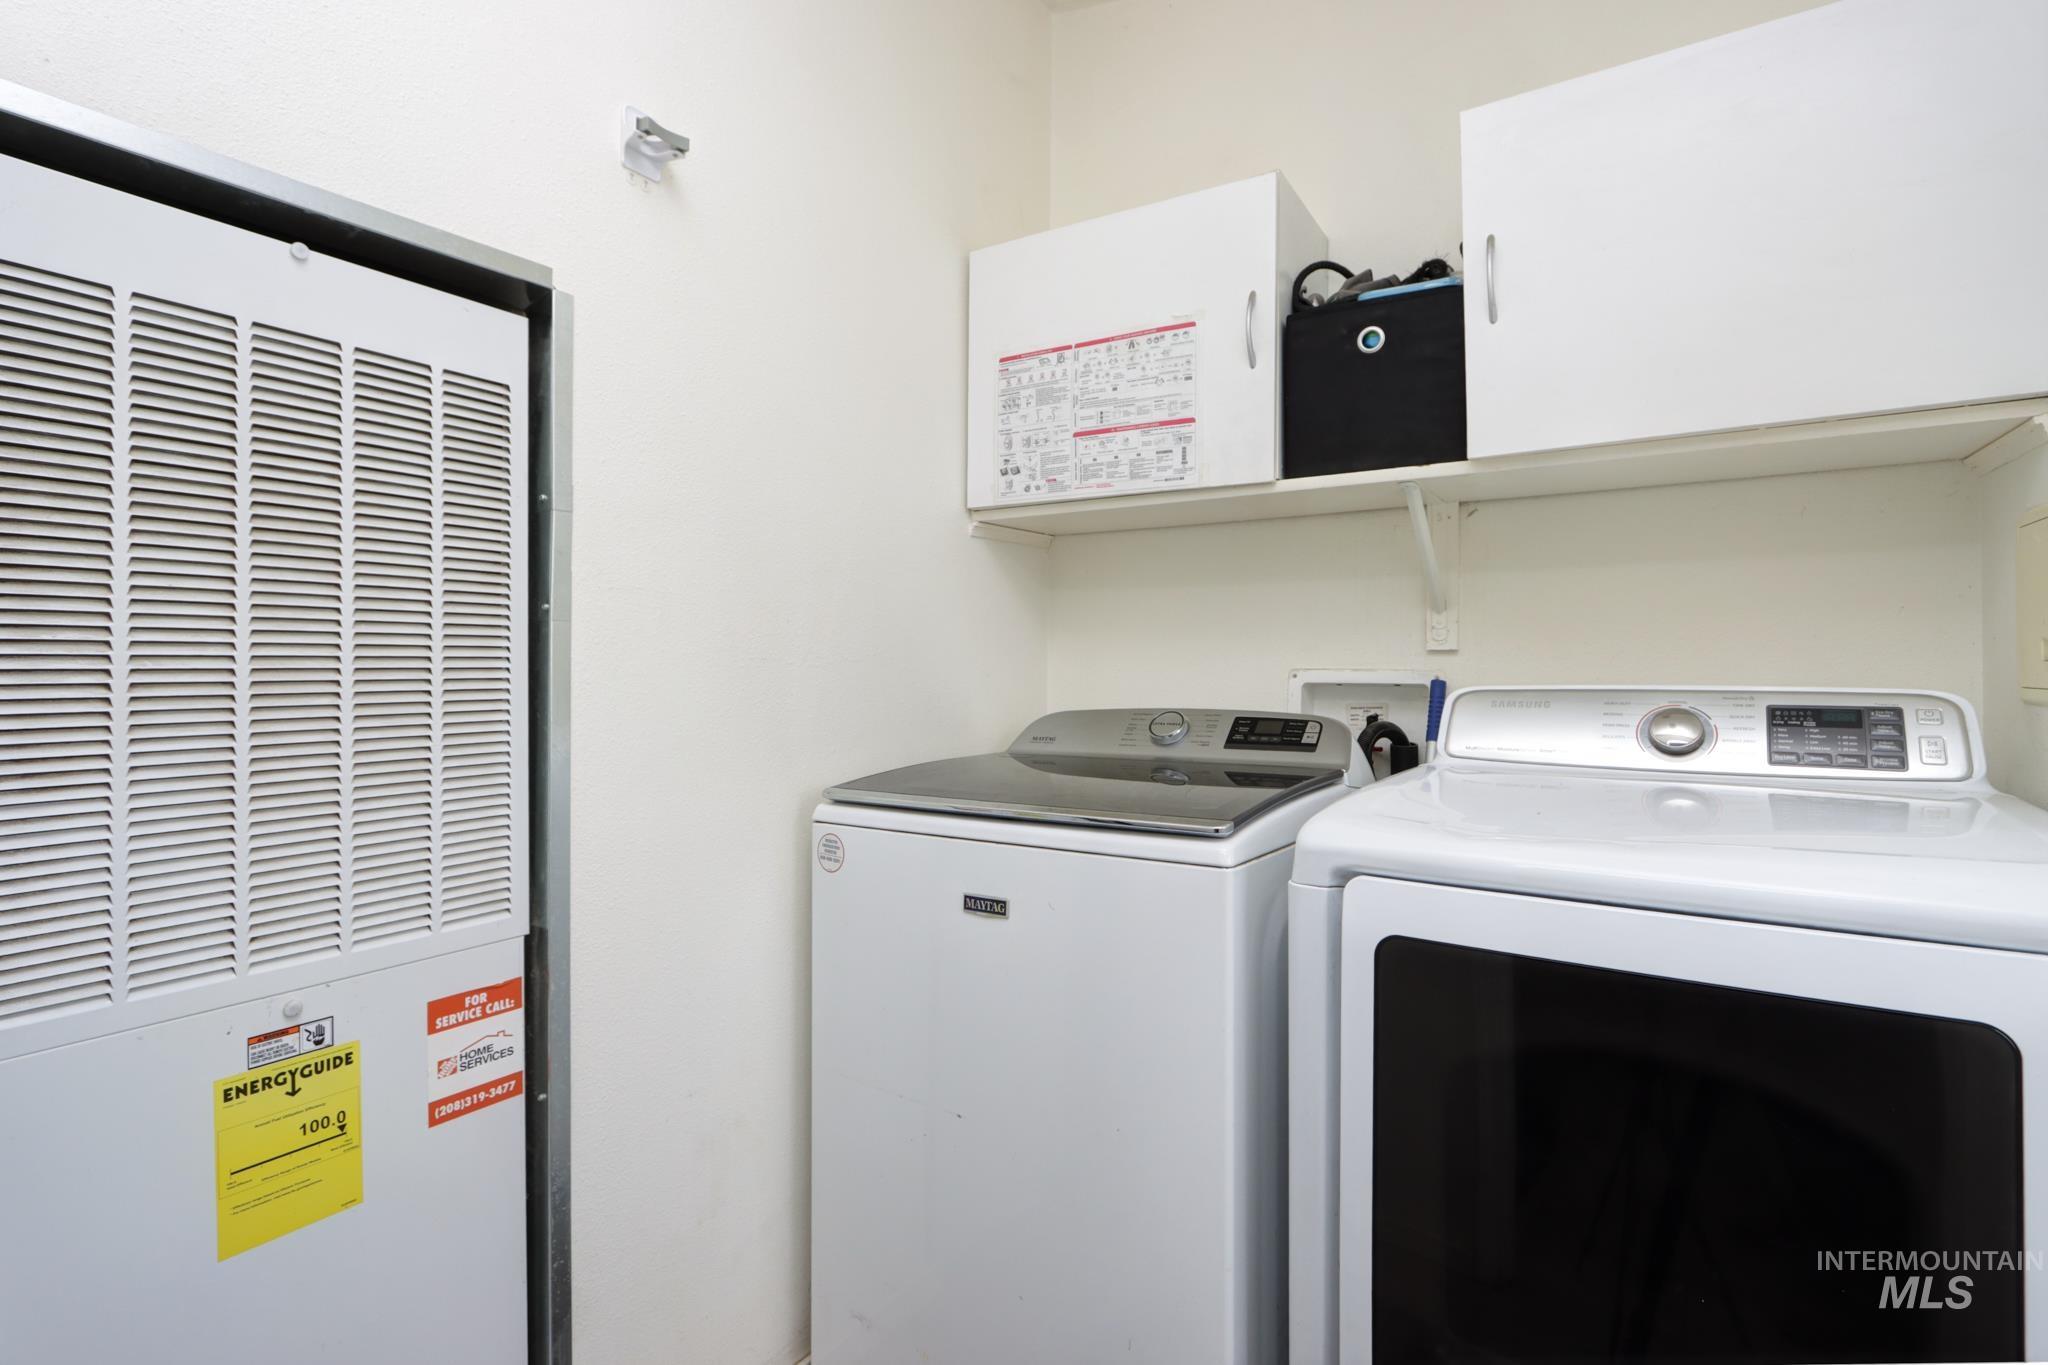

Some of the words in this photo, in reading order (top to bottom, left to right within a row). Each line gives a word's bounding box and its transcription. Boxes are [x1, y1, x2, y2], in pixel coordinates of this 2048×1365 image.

[1490, 700, 1551, 709] SAMSUNG
[965, 897, 1006, 914] MAYTAG
[465, 992, 487, 1008] FOR
[435, 1006, 482, 1029] SERVICE
[485, 998, 515, 1014] CALL:
[459, 1044, 494, 1061] HOME
[459, 1046, 514, 1072] SERVICES
[223, 1052, 353, 1103] ENERGYGUIDE
[434, 1080, 516, 1119] (208)319-3477
[299, 1110, 346, 1136] 100.0
